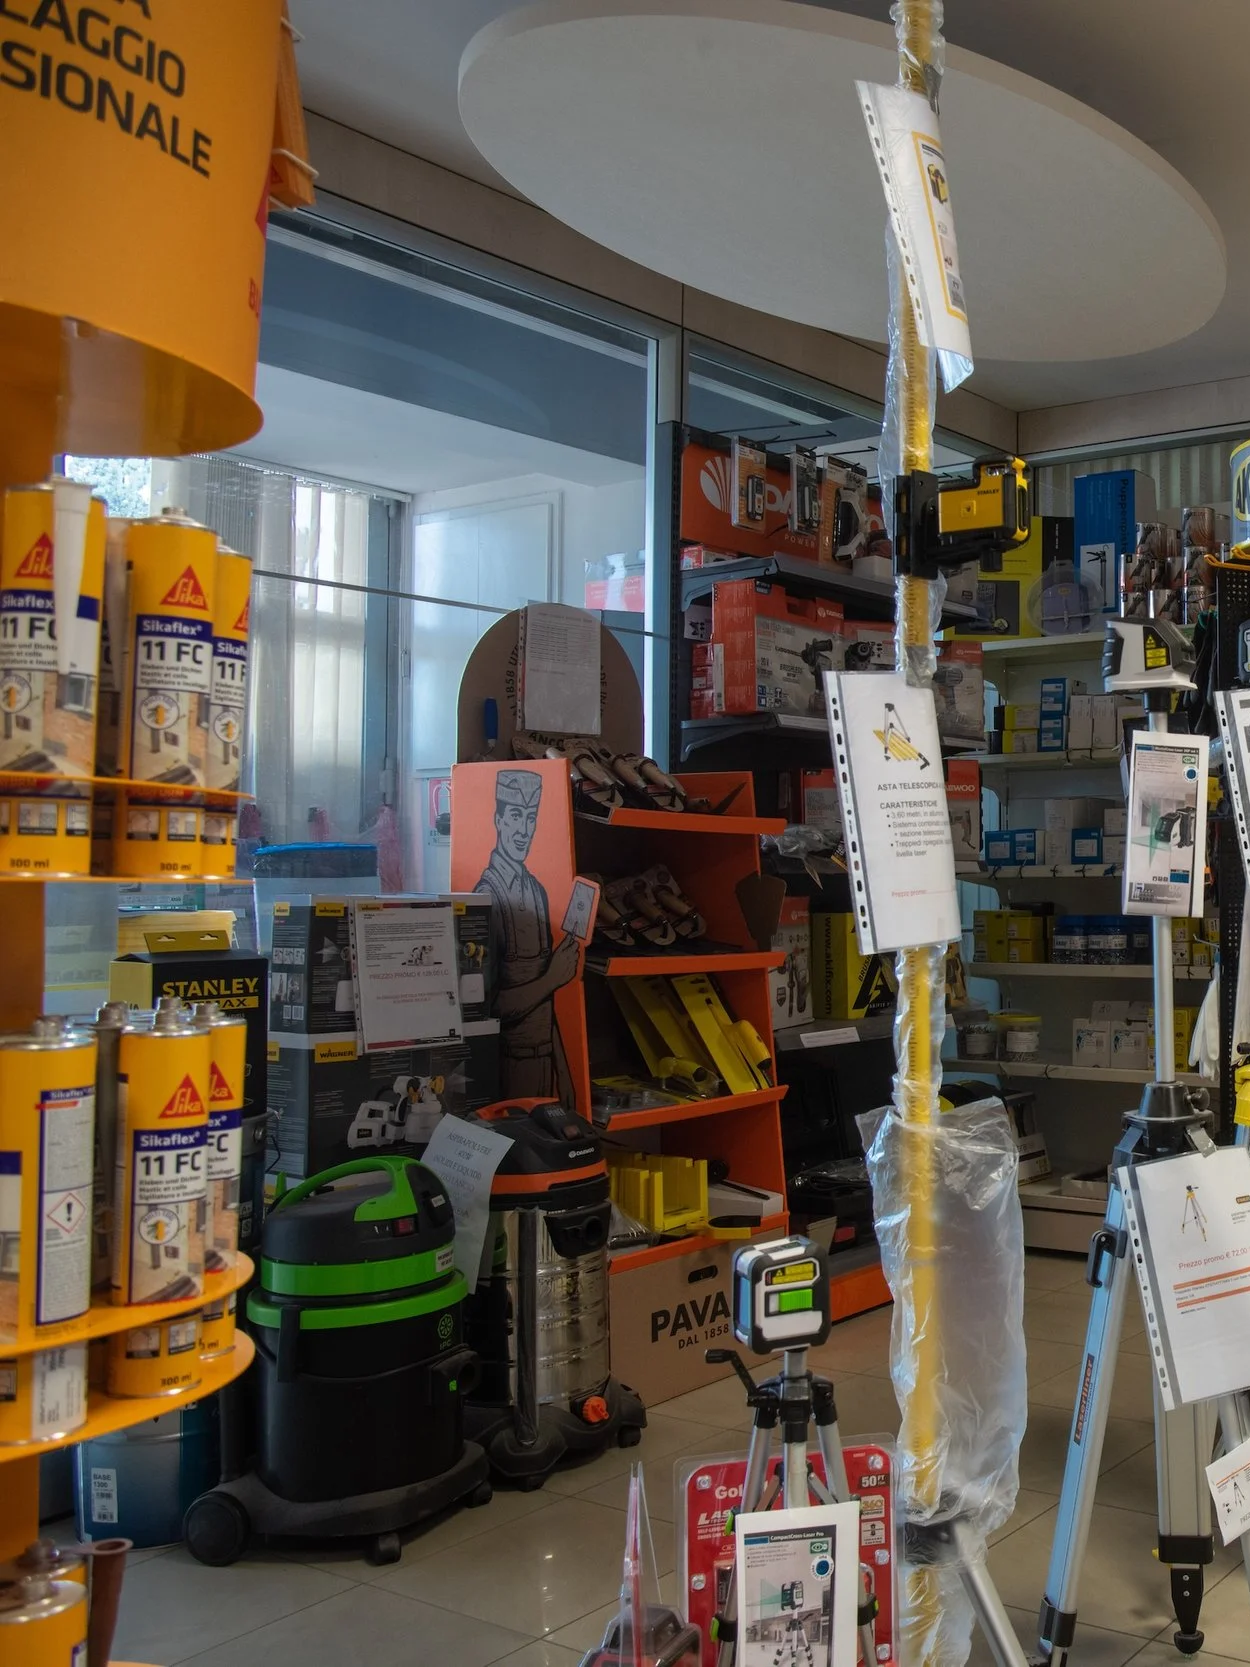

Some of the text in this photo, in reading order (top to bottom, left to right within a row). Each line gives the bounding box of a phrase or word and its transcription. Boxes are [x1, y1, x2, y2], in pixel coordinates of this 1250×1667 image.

[0, 40, 212, 180] SIONALE
[168, 579, 205, 605] Sika
[142, 641, 204, 665] 11 FC
[216, 661, 236, 680] 11
[878, 783, 897, 791] ASTA
[880, 800, 937, 809] CARATTERISTICHE
[162, 977, 259, 998] STANLEY
[166, 1090, 202, 1115] Sika
[141, 1150, 202, 1176] 11 FC
[1178, 1258, 1202, 1271] Prezzo
[1203, 1252, 1226, 1266] promo
[678, 1322, 730, 1349] DAL 1858
[861, 1475, 877, 1488] 50
